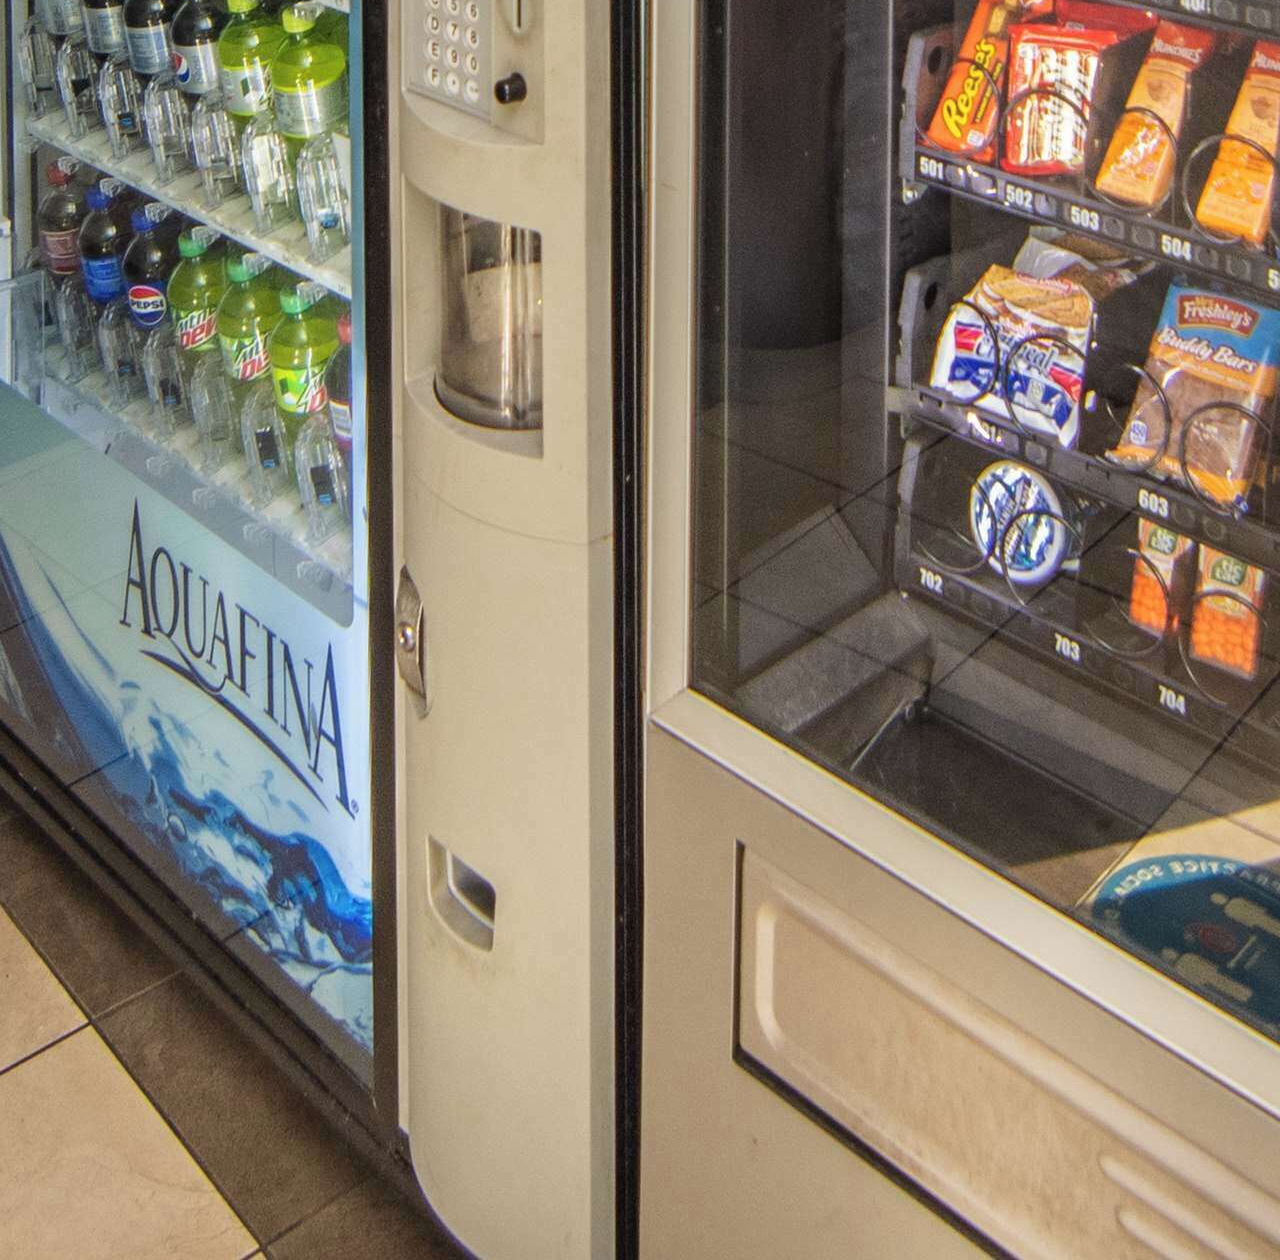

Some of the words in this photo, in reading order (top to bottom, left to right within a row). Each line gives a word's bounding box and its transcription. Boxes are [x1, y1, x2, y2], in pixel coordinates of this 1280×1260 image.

[919, 156, 945, 174] 501
[1006, 185, 1033, 207] 502
[1071, 205, 1100, 231] 503
[1161, 234, 1192, 260] 504
[1157, 324, 1214, 361] Buddy
[1213, 346, 1257, 373] Bars
[1138, 490, 1169, 517] 603
[920, 567, 945, 594] 702
[119, 496, 356, 821] AQUAFINA
[1055, 633, 1081, 661] 703
[1159, 686, 1186, 715] 704
